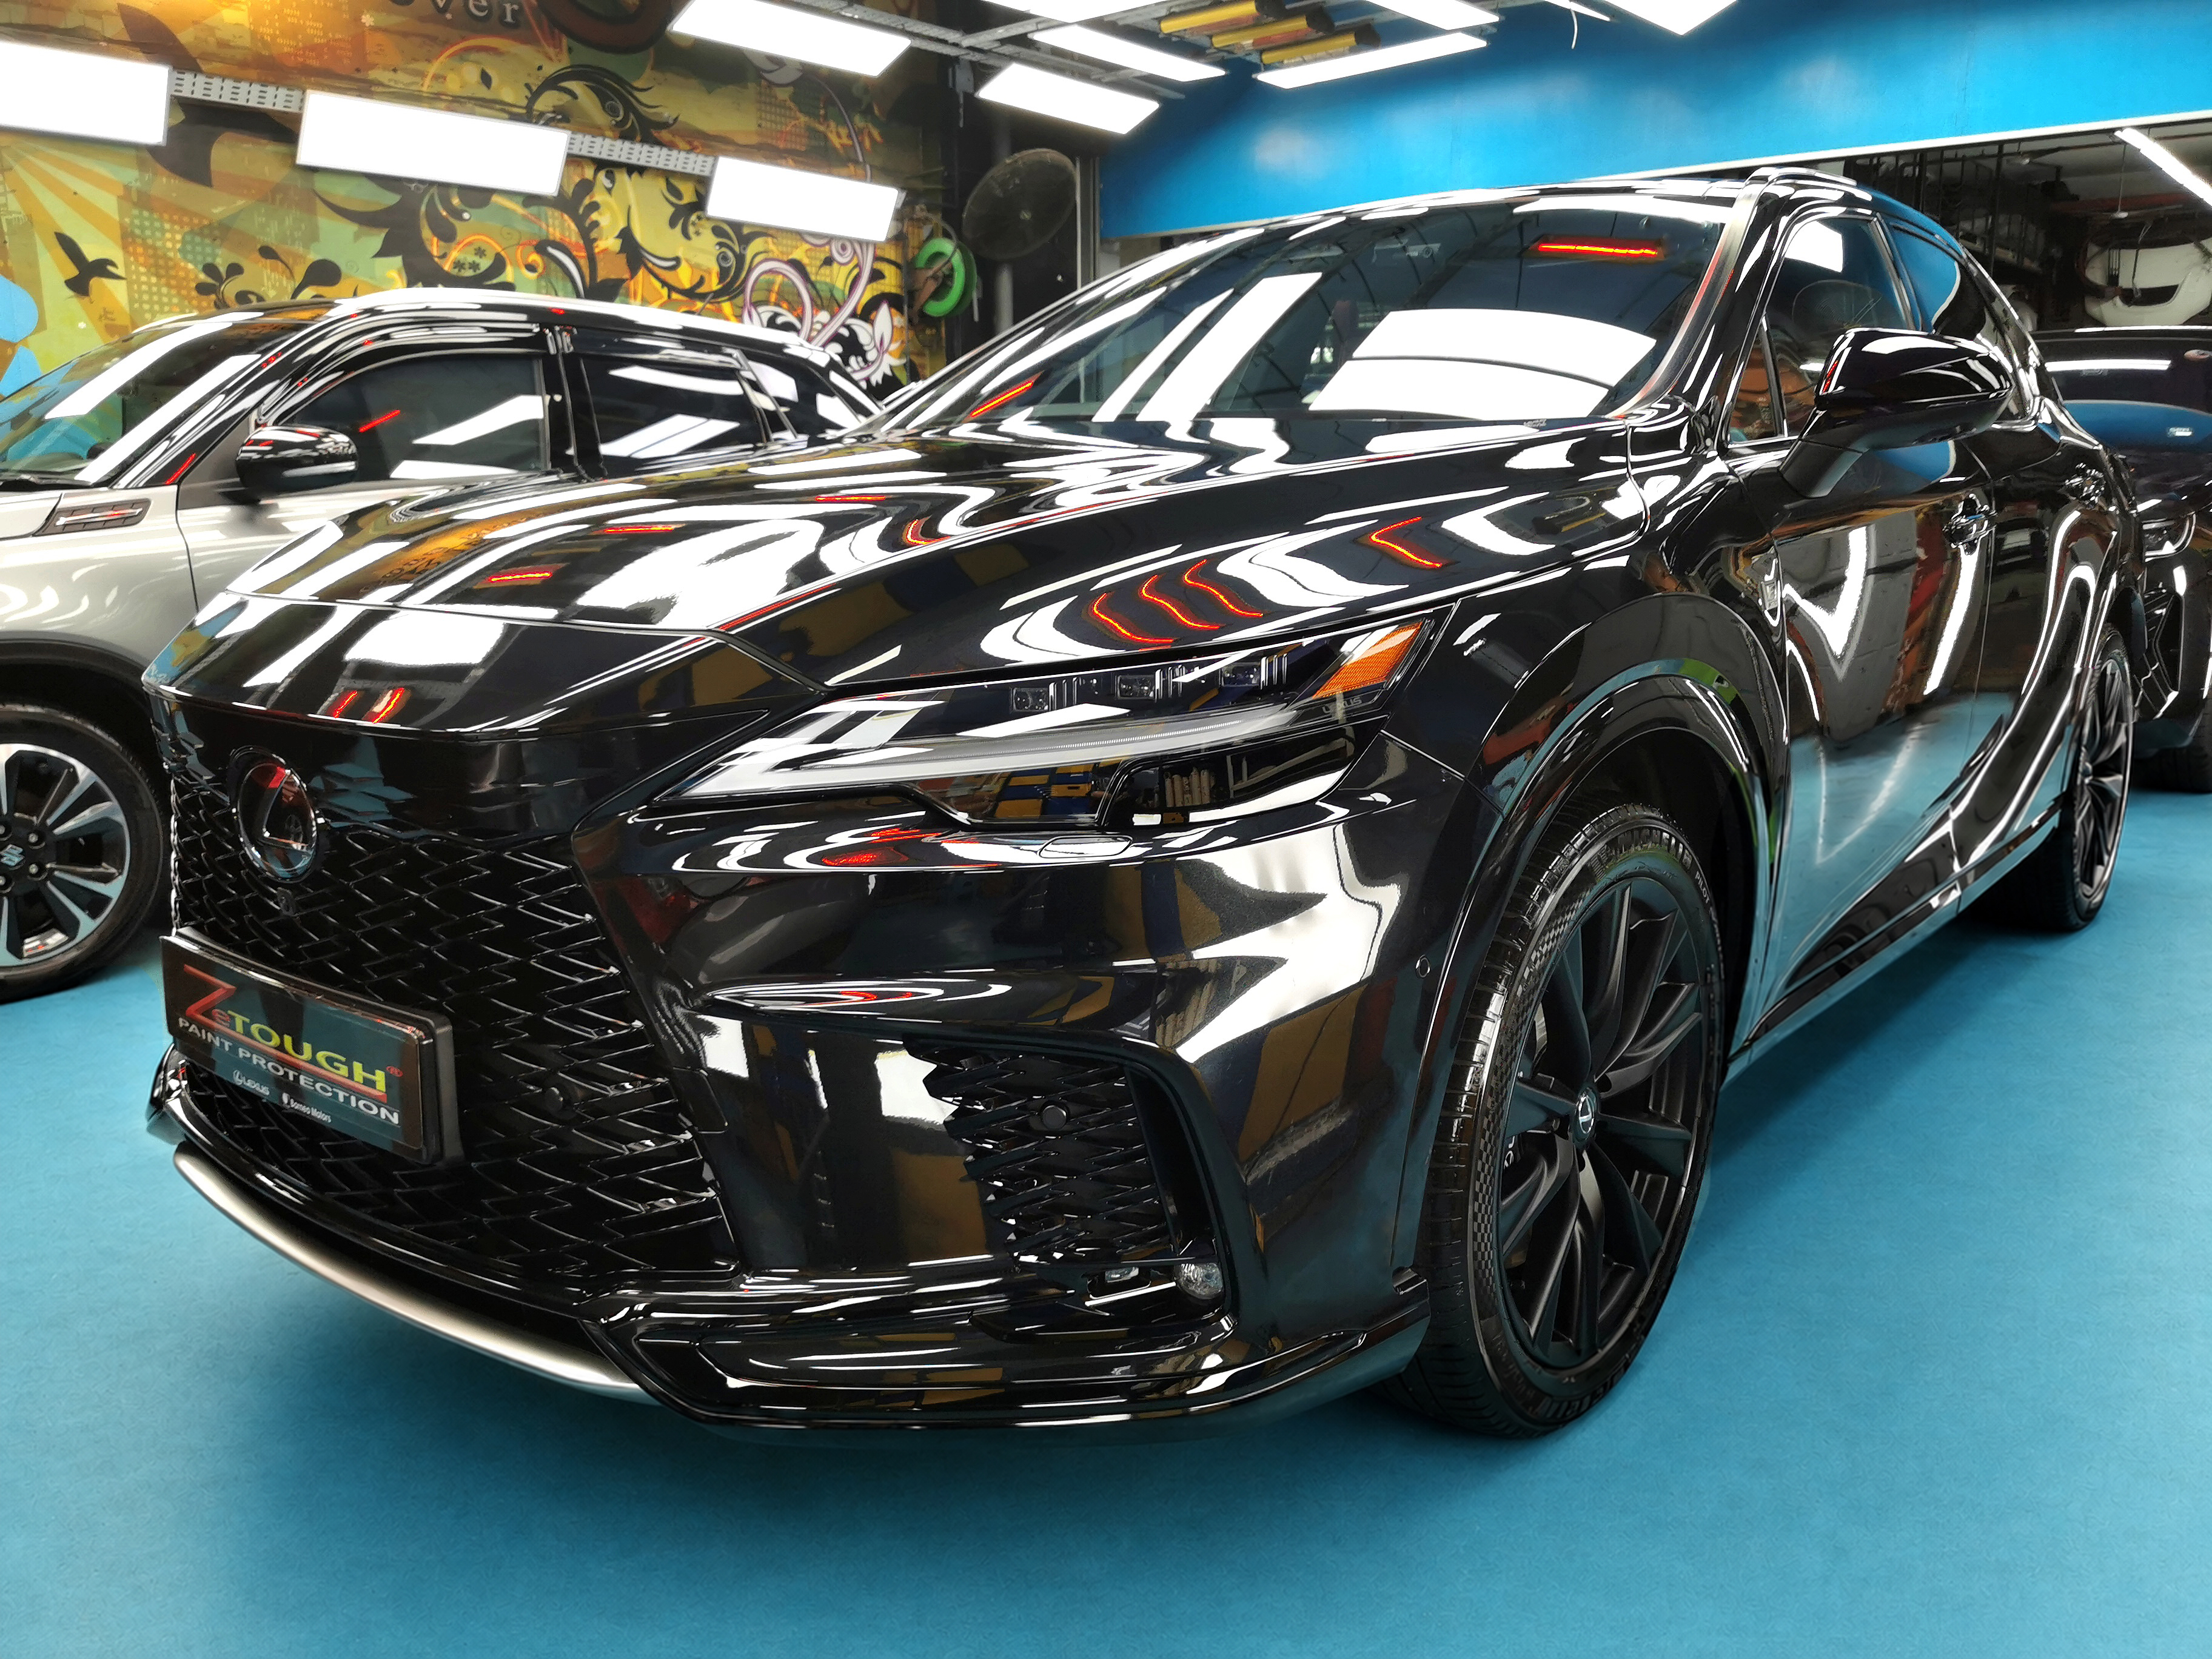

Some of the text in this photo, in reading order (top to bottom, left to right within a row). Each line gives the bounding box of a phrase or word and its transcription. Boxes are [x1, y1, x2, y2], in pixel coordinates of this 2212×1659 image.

[1695, 871, 1710, 904] PILOT
[178, 1017, 399, 1125] PAINT PROTECTION
